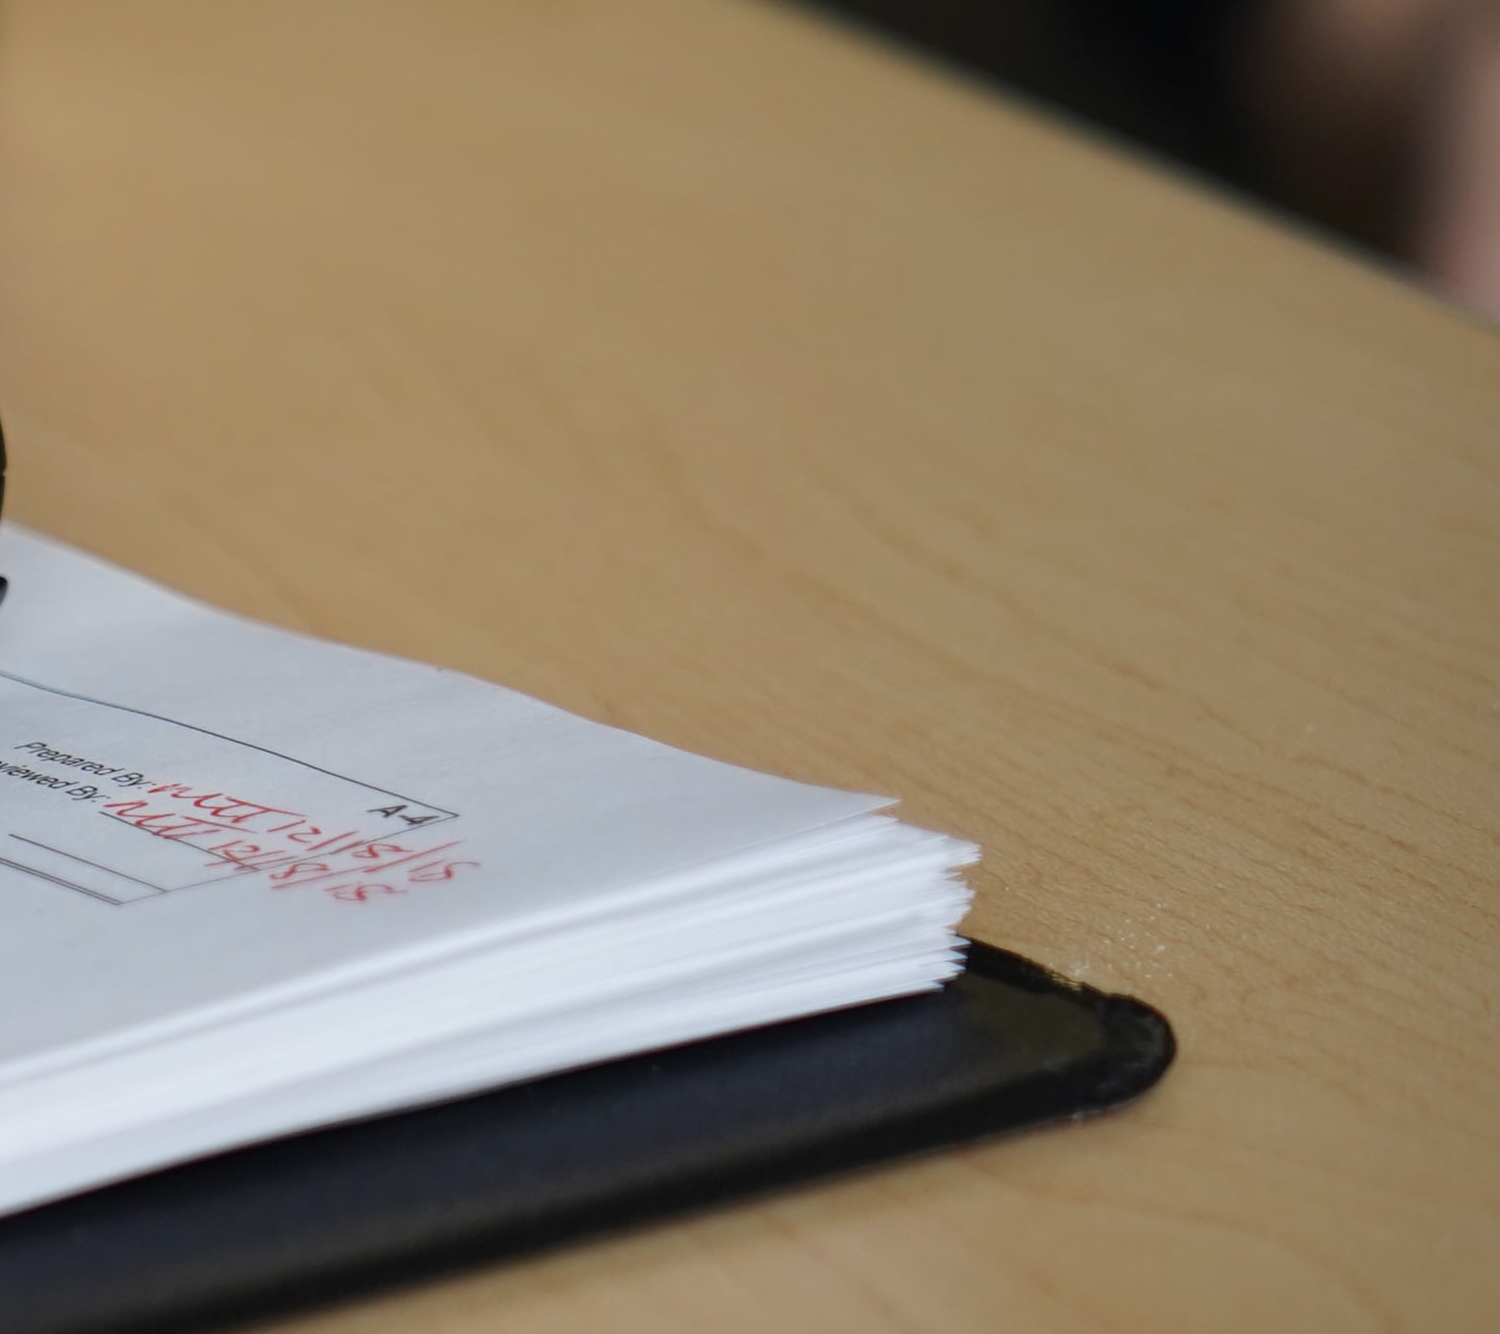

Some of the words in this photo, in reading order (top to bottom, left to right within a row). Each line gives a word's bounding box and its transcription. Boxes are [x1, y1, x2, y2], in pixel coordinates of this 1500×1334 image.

[14, 739, 120, 777] Prepared
[110, 768, 159, 793] By:
[65, 781, 114, 806] By:
[366, 801, 442, 827] A-4
